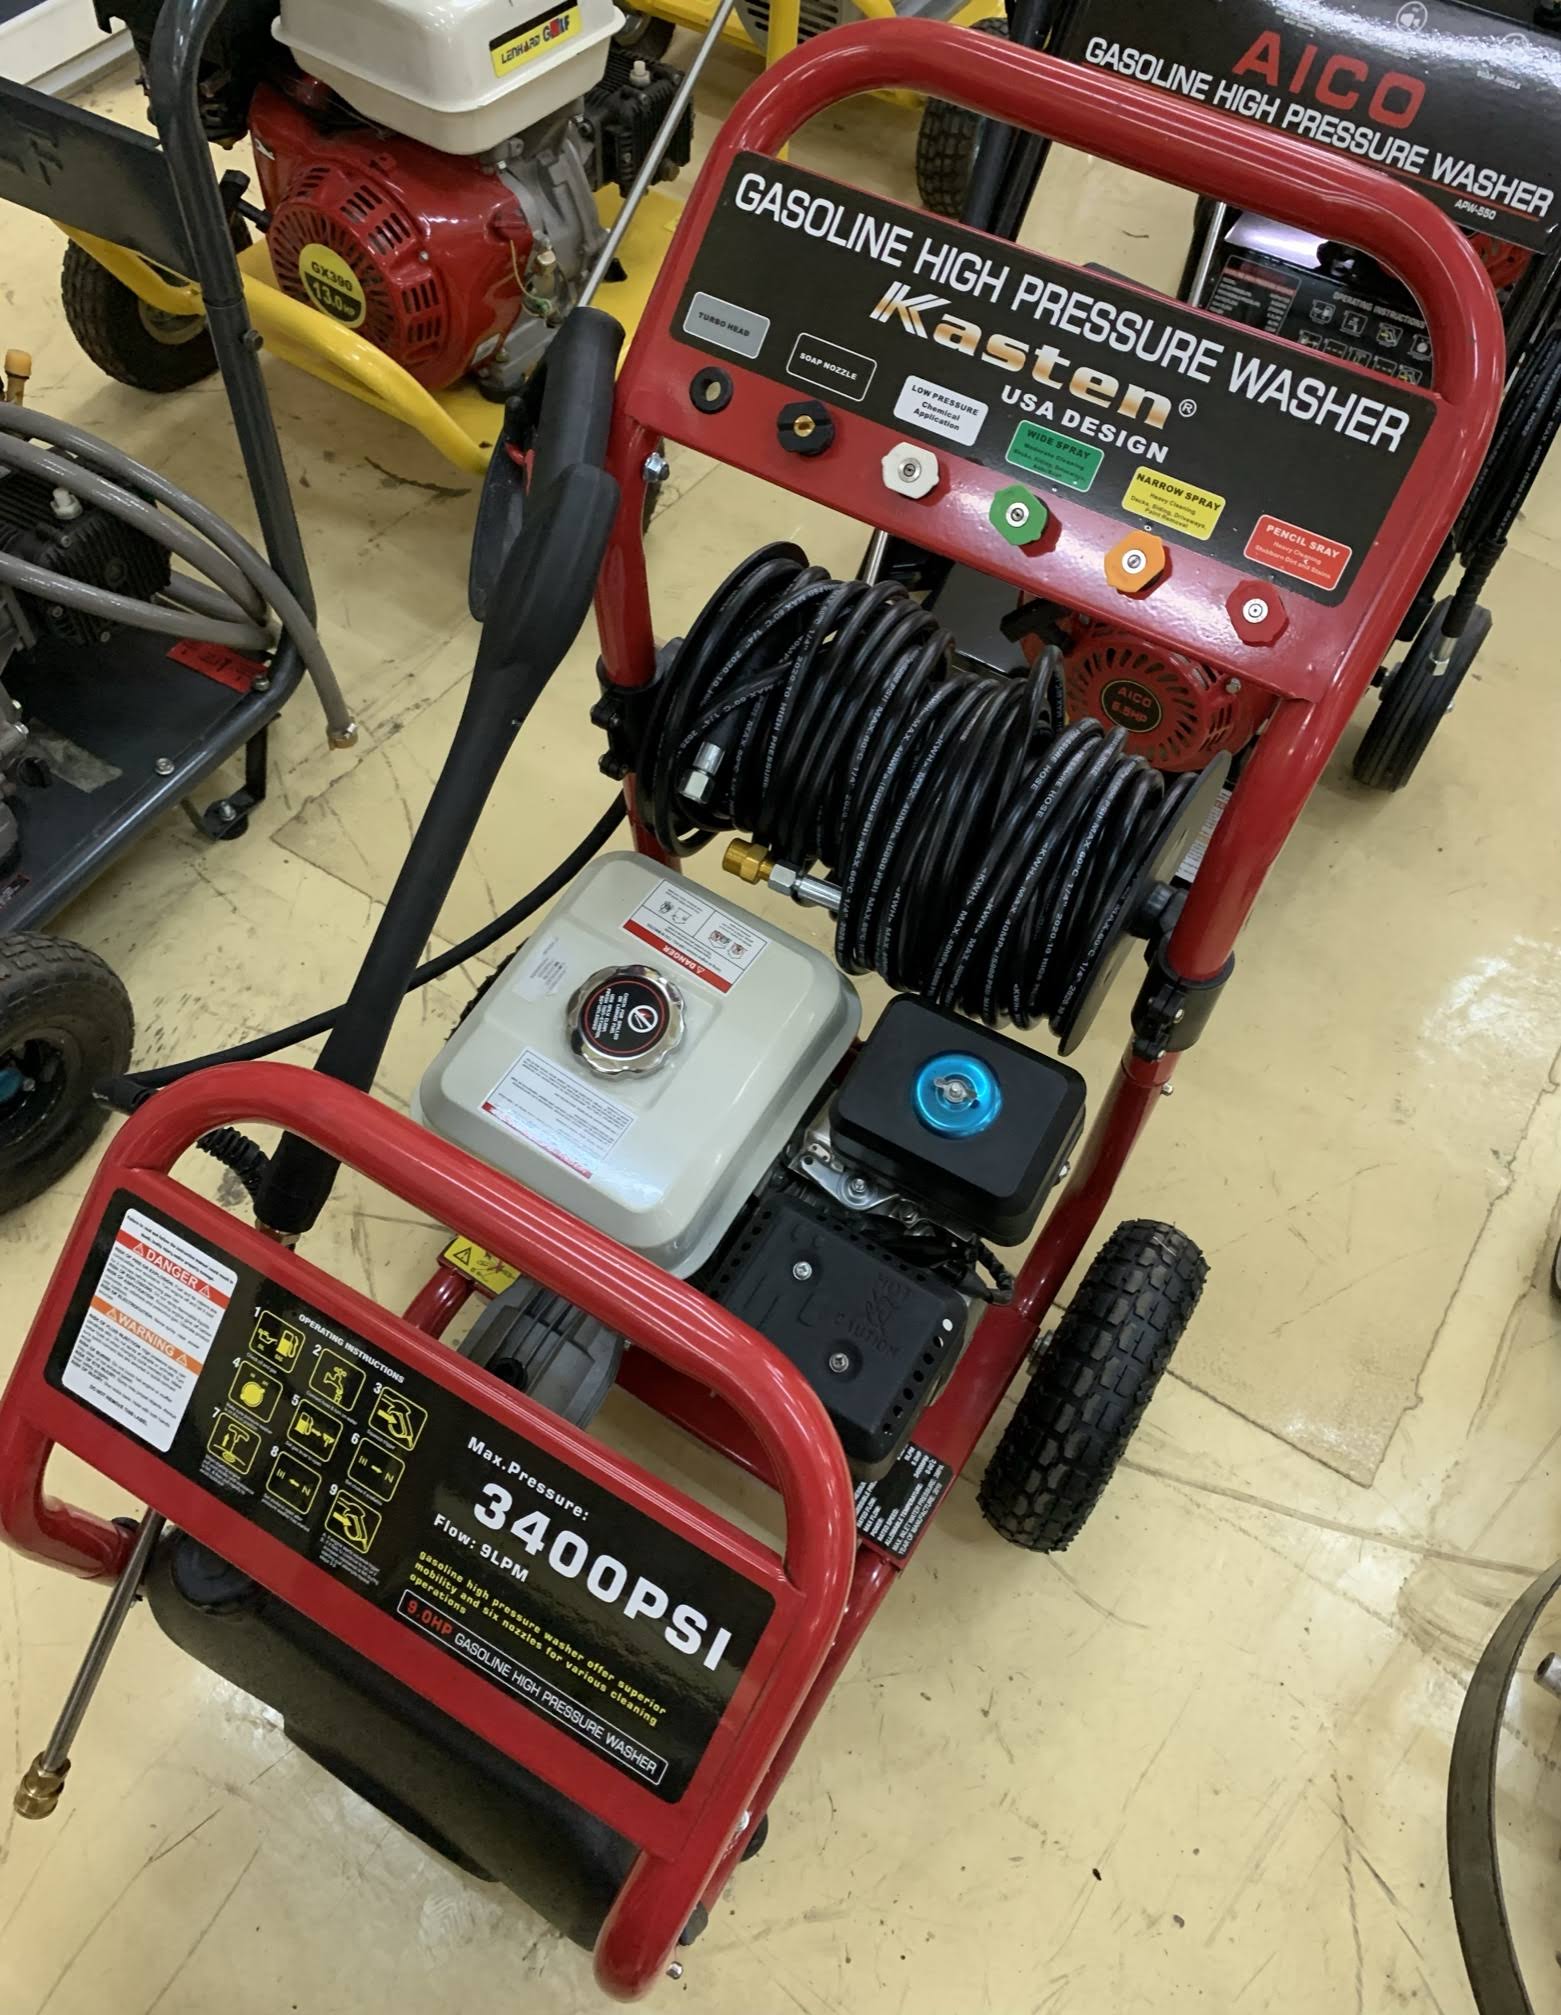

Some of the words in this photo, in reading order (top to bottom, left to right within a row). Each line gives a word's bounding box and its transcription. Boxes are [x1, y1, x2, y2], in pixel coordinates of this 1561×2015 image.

[1232, 29, 1426, 129] AICO
[1084, 36, 1214, 100] GASOLINE
[1212, 78, 1280, 123] HIGH
[1282, 103, 1429, 174] PRESSURE
[1431, 152, 1555, 218] WASHER
[698, 311, 726, 328] TURBO
[727, 321, 750, 337] HEAD
[734, 172, 914, 267] GASOLINE
[913, 237, 1010, 303] HIGH
[1010, 273, 1224, 383] PRESSURE
[1228, 351, 1410, 453] WASHER
[799, 352, 823, 366] SOAP
[822, 361, 858, 381] NOZZLE
[870, 280, 1172, 430] Kasten
[911, 384, 932, 399] LOW
[931, 392, 979, 416] PRESSURE
[921, 401, 961, 422] Chemical
[913, 408, 960, 431] Application
[1000, 384, 1053, 420] USA
[1061, 408, 1169, 464] DESIGN
[1026, 428, 1054, 446] WIDE
[1054, 440, 1091, 460] SPRAY
[1136, 472, 1184, 497] NARROW
[1185, 492, 1222, 512] SPRAY
[1266, 524, 1306, 547] PENCIL
[1308, 540, 1340, 559] SRAY
[1117, 687, 1152, 708] AICO
[1030, 765, 1051, 791] HOSE
[1035, 790, 1057, 818] HOSE
[662, 944, 695, 971] DANGER
[146, 1249, 199, 1290] DANGER
[253, 1306, 261, 1318] 1
[117, 1311, 175, 1358] WARNING
[298, 1314, 345, 1346] OPERATING
[344, 1342, 405, 1384] INSTRUCTIONS
[312, 1343, 322, 1357] 2
[232, 1357, 241, 1368] 4
[291, 1393, 301, 1406] 5
[373, 1382, 383, 1395] 3
[212, 1406, 221, 1419] 7
[270, 1445, 280, 1458] 8
[350, 1432, 361, 1445] 6
[328, 1483, 339, 1496] 9
[467, 1436, 589, 1521] Max.Pressure:
[433, 1513, 477, 1550] Flow:
[480, 1543, 529, 1583] 9LPM
[474, 1483, 731, 1672] 3400PSI
[409, 1573, 468, 1615] operations
[414, 1561, 457, 1596] mobility
[460, 1590, 480, 1609] and
[482, 1606, 499, 1623] six
[502, 1618, 543, 1650] nozzles
[546, 1646, 563, 1663] for
[565, 1660, 607, 1693] various
[610, 1689, 658, 1728] cleaning
[418, 1549, 464, 1584] gasoline
[467, 1579, 489, 1601] high
[492, 1595, 541, 1635] pressure
[543, 1630, 585, 1661] washer
[587, 1659, 615, 1683] offer
[618, 1678, 667, 1716] superior
[407, 1599, 454, 1637] 9.0HP
[453, 1632, 513, 1678] GASOLINE
[511, 1670, 542, 1698] HIGH
[542, 1691, 606, 1740] PRESSURE
[605, 1732, 658, 1776] WASHER
